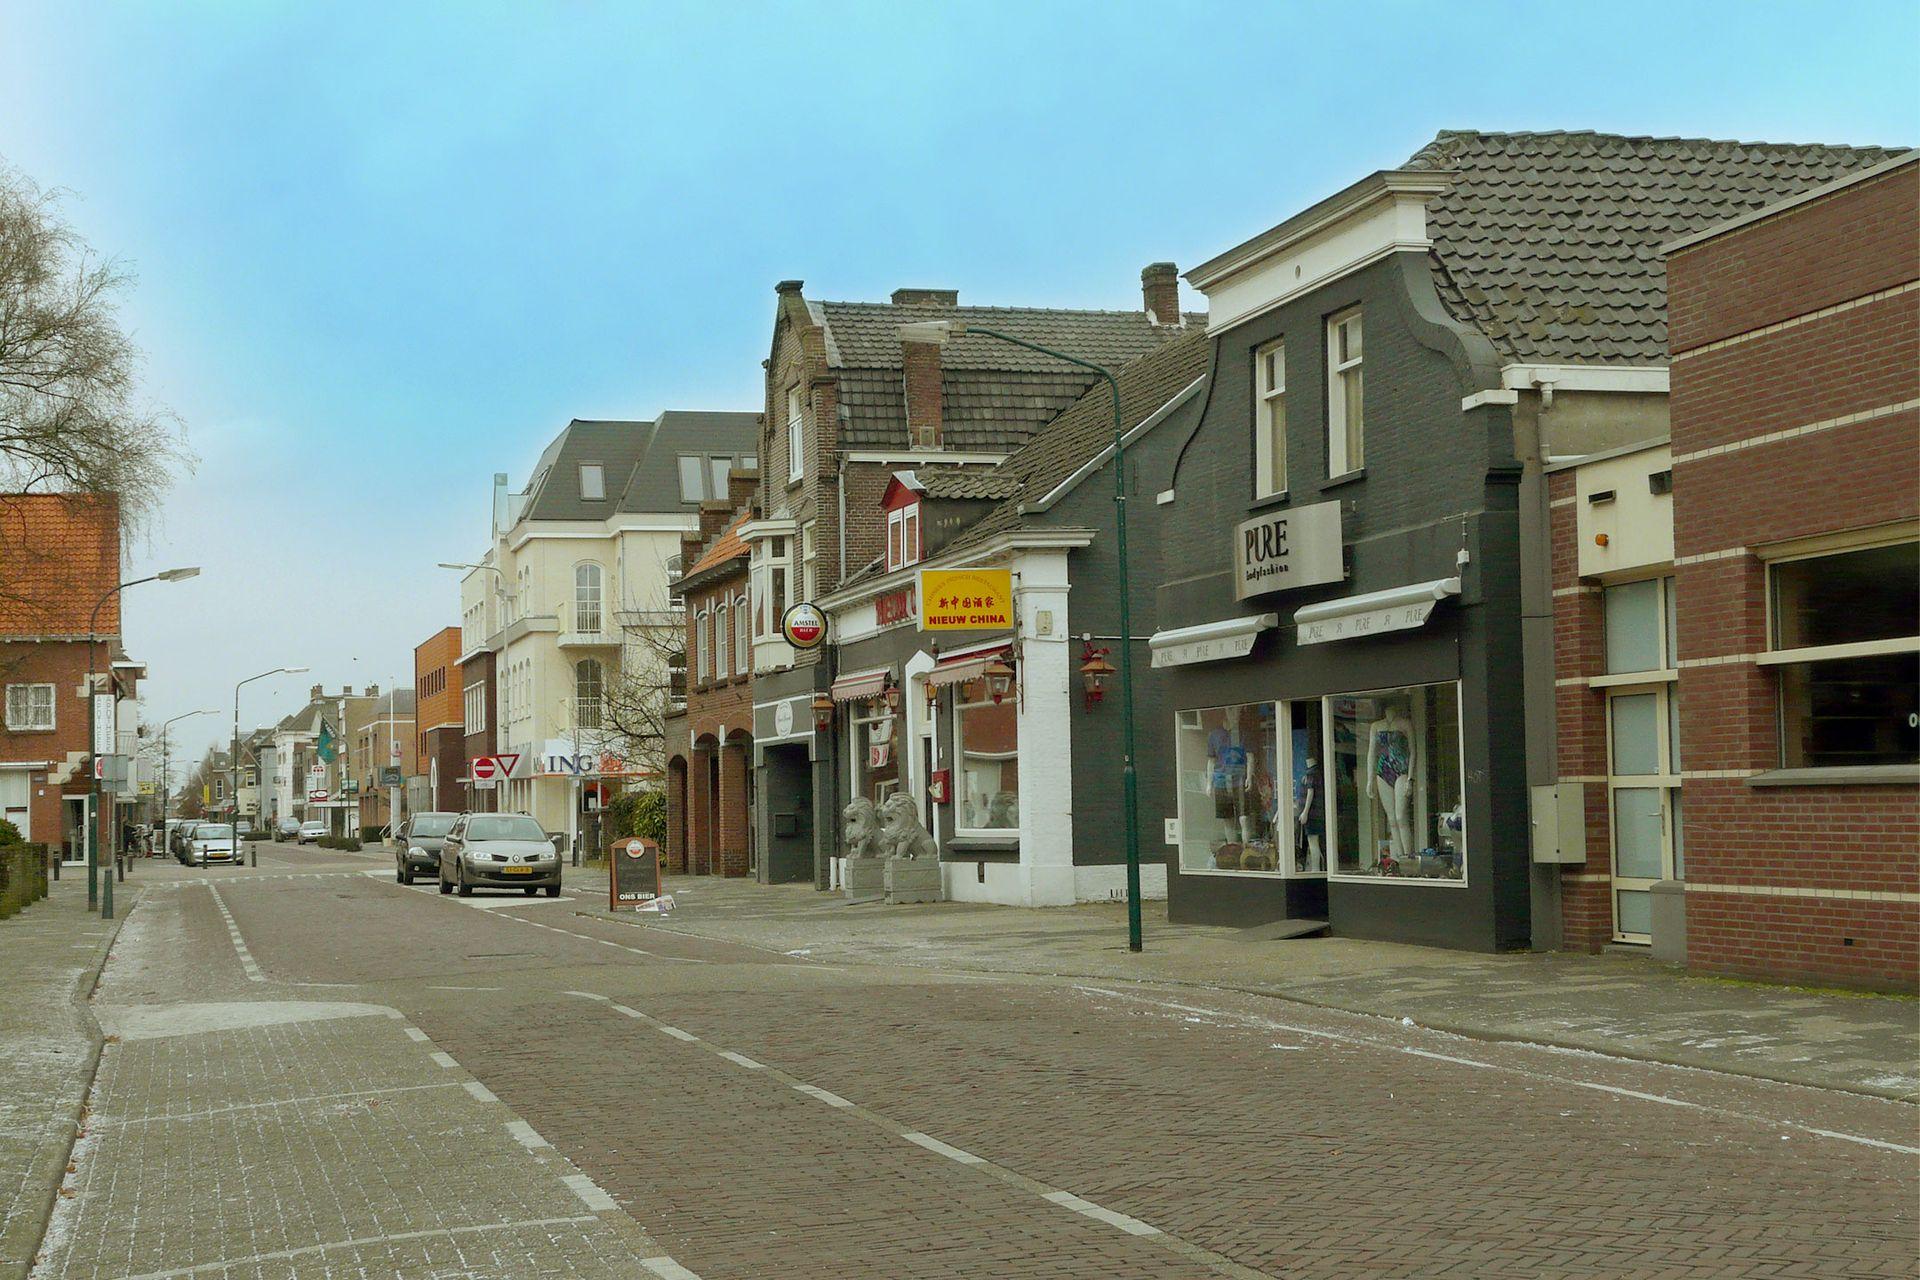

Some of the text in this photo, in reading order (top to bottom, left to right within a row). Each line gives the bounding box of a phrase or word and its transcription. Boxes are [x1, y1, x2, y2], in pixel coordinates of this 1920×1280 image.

[1245, 520, 1289, 565] PURE
[928, 614, 1006, 625] NIEUW CHINA
[548, 755, 594, 772] ING
